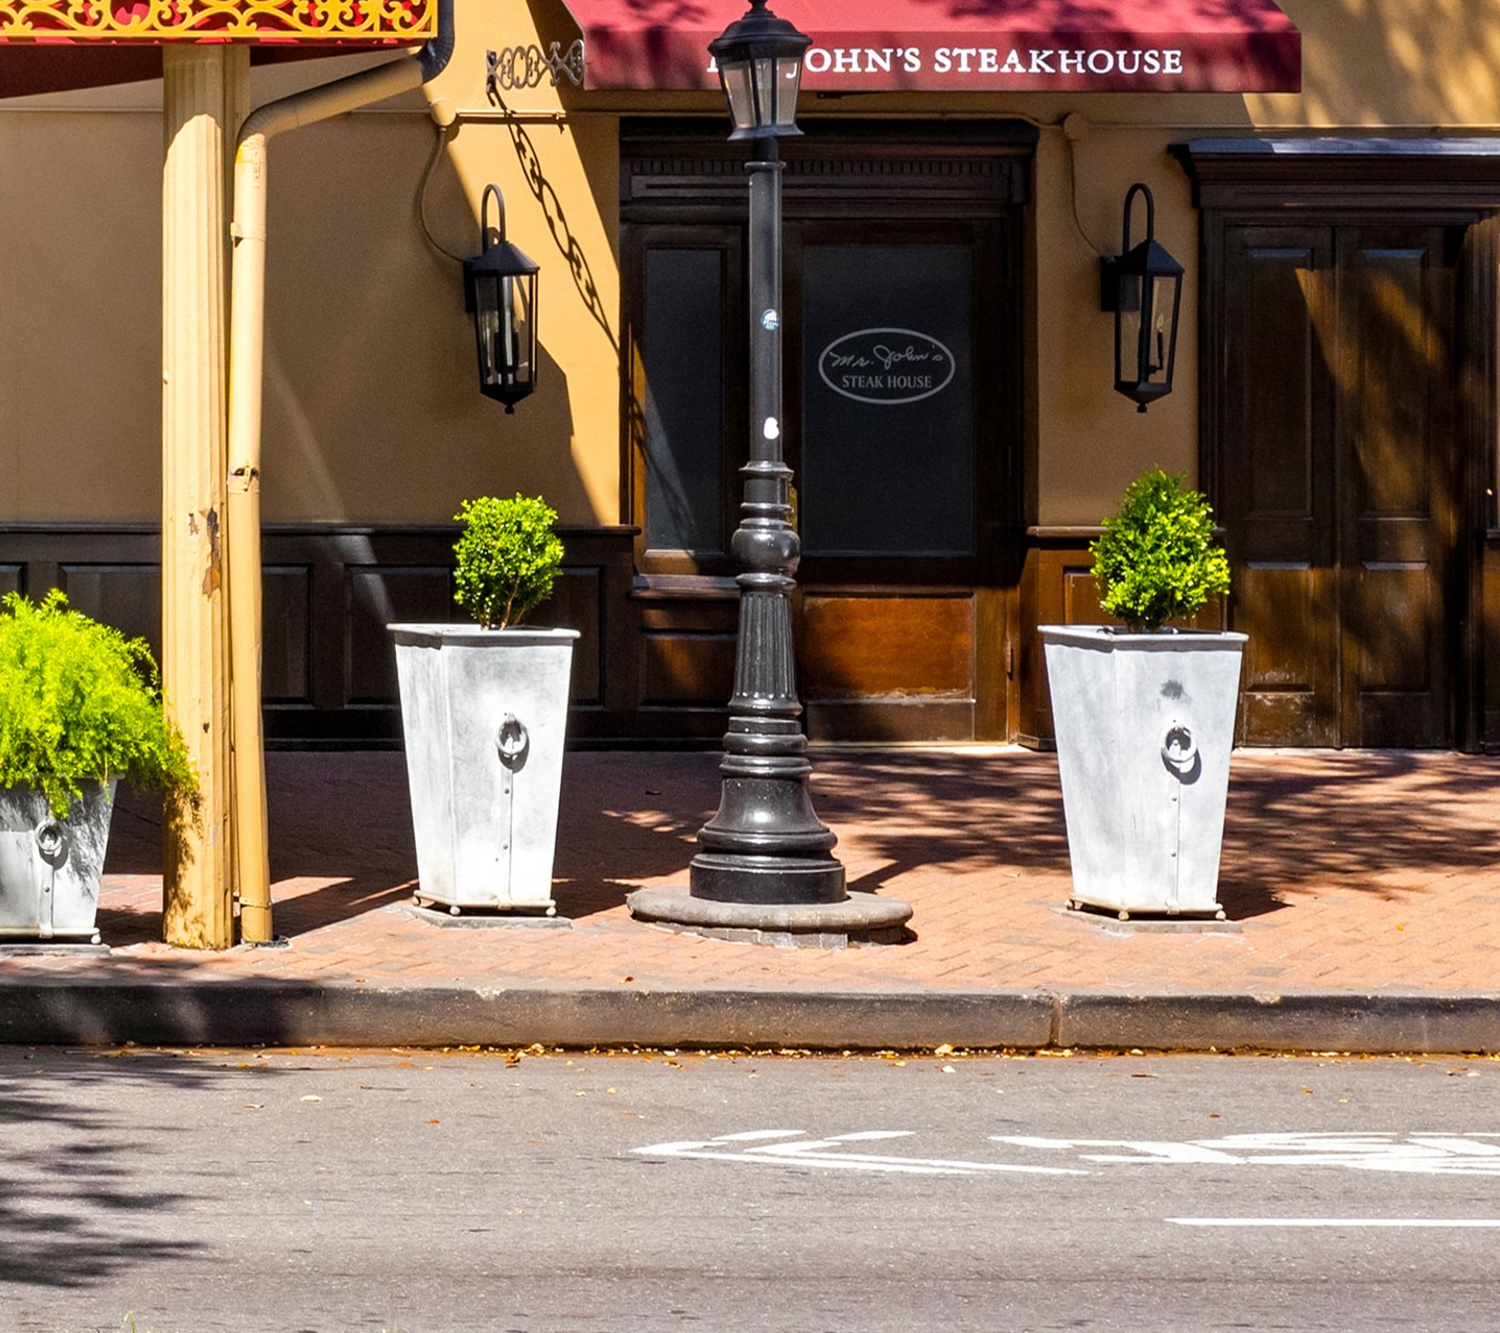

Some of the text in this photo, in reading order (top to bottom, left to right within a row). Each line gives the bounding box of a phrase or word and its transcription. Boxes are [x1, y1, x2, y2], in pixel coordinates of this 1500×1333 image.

[934, 47, 1183, 74] STEAKHOUSE
[829, 344, 943, 370] Mr. John's
[842, 375, 932, 389] STEAK HOUSE
